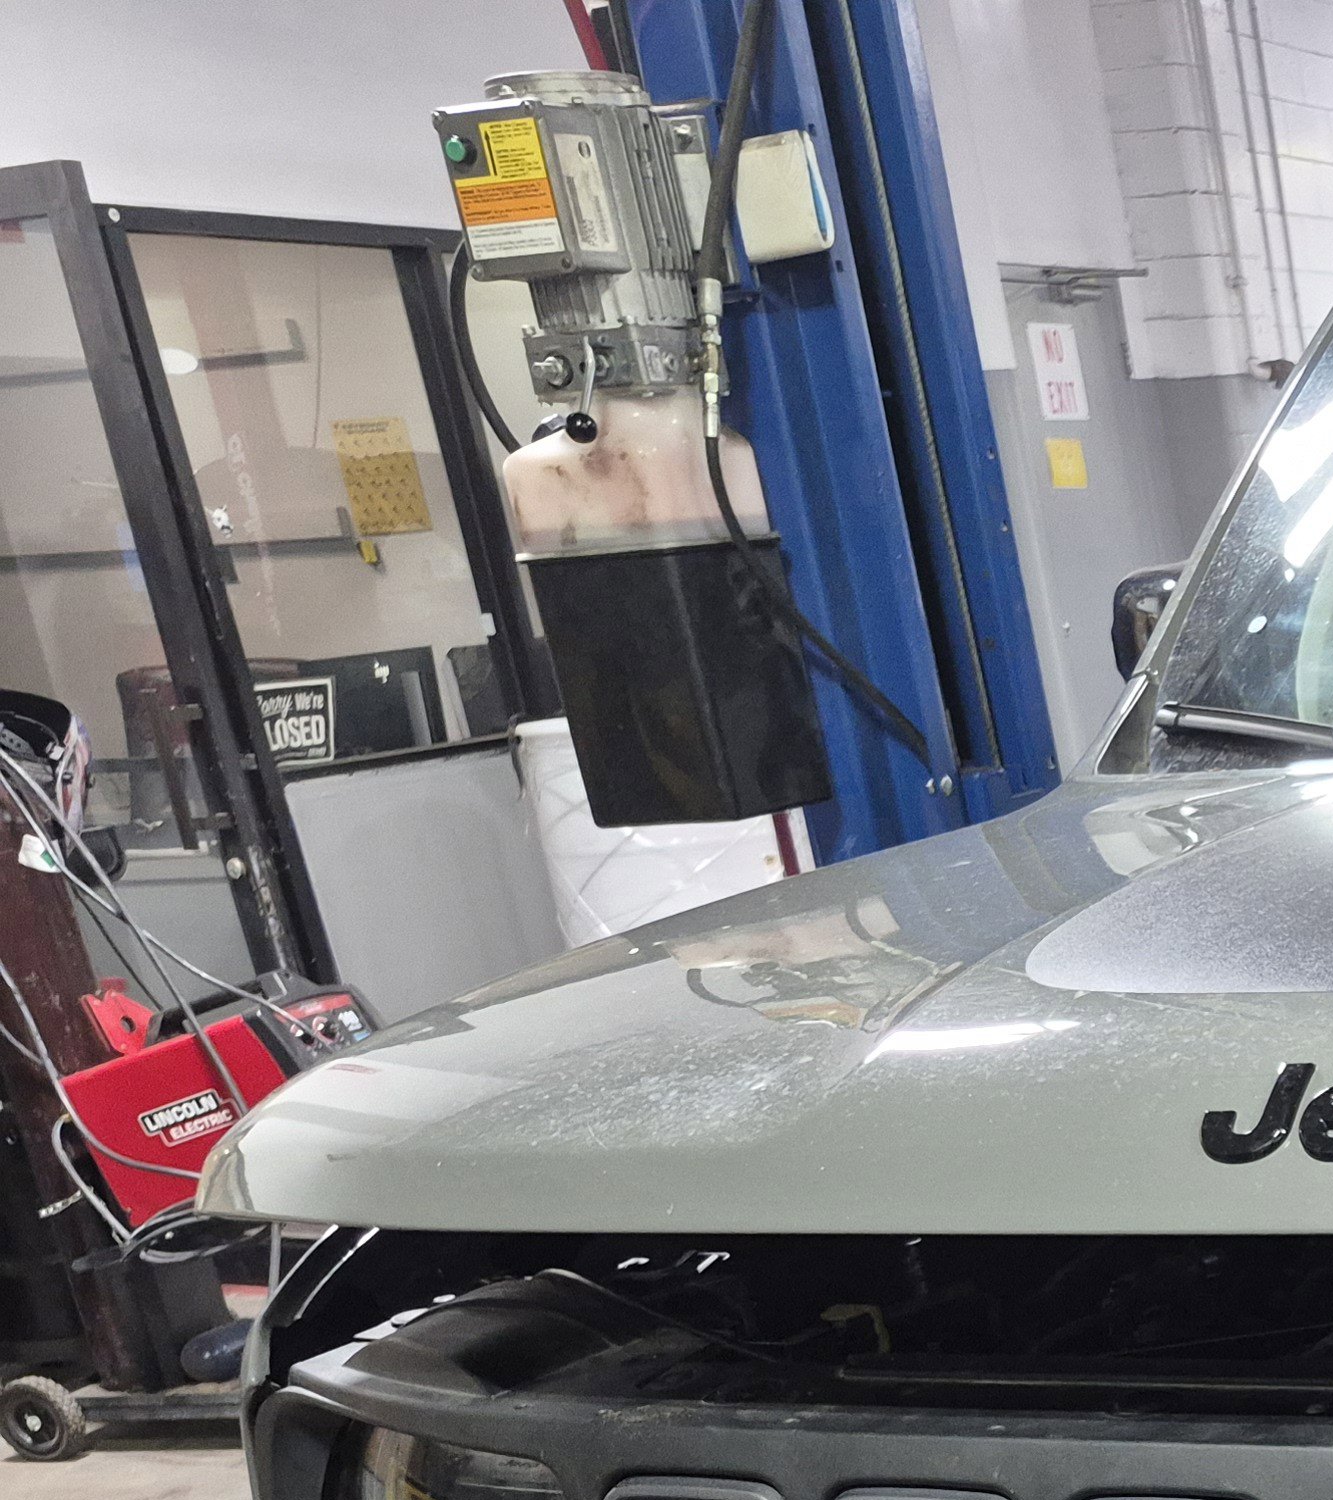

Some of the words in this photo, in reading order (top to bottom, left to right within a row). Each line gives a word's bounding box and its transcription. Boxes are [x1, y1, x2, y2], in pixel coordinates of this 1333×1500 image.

[1047, 380, 1078, 414] EXIT
[294, 691, 324, 711] We're
[263, 714, 326, 752] LOSED
[144, 1093, 218, 1132] LINCOLN
[169, 1108, 233, 1140] ELECTRIC
